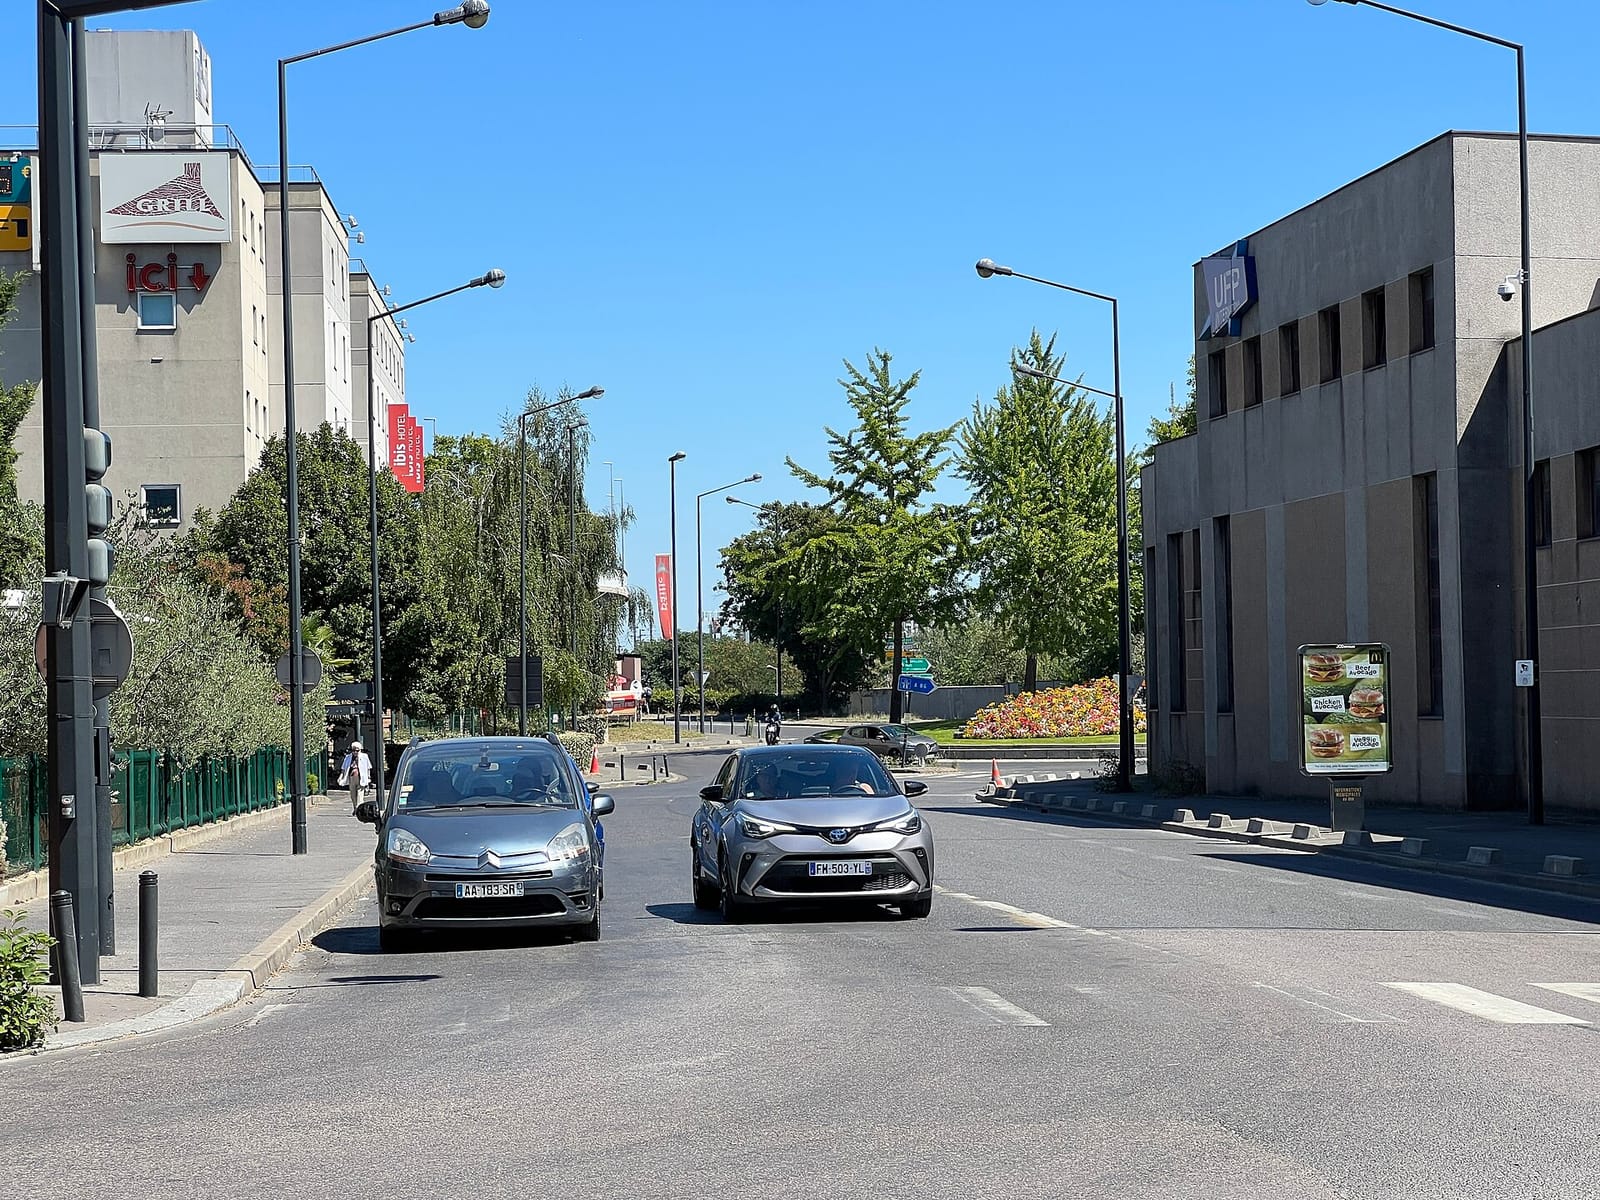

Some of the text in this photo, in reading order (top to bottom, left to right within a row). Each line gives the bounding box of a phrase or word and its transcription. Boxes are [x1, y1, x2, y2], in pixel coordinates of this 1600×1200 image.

[136, 198, 211, 213] GRILL
[1214, 267, 1240, 308] UFP
[393, 413, 406, 467] ibis HOTEL
[464, 883, 515, 897] AA-183-SR
